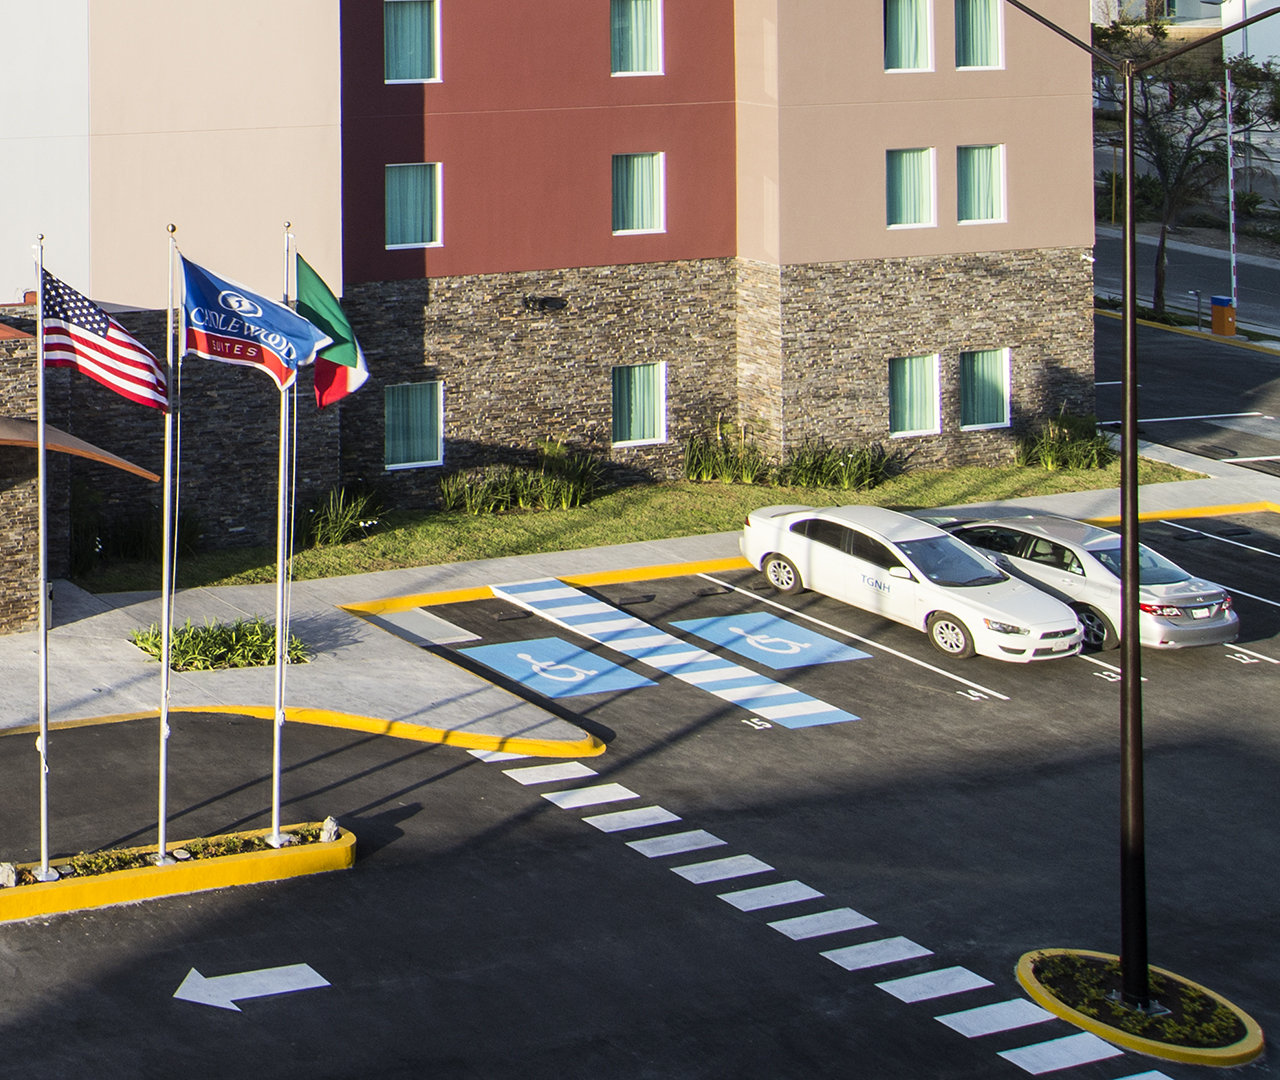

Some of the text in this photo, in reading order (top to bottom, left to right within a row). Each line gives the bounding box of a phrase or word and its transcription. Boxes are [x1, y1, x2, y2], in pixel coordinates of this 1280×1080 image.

[211, 339, 258, 357] SUITES
[861, 574, 891, 593] TGNH
[1224, 653, 1260, 664] 12
[740, 717, 773, 730] 15
